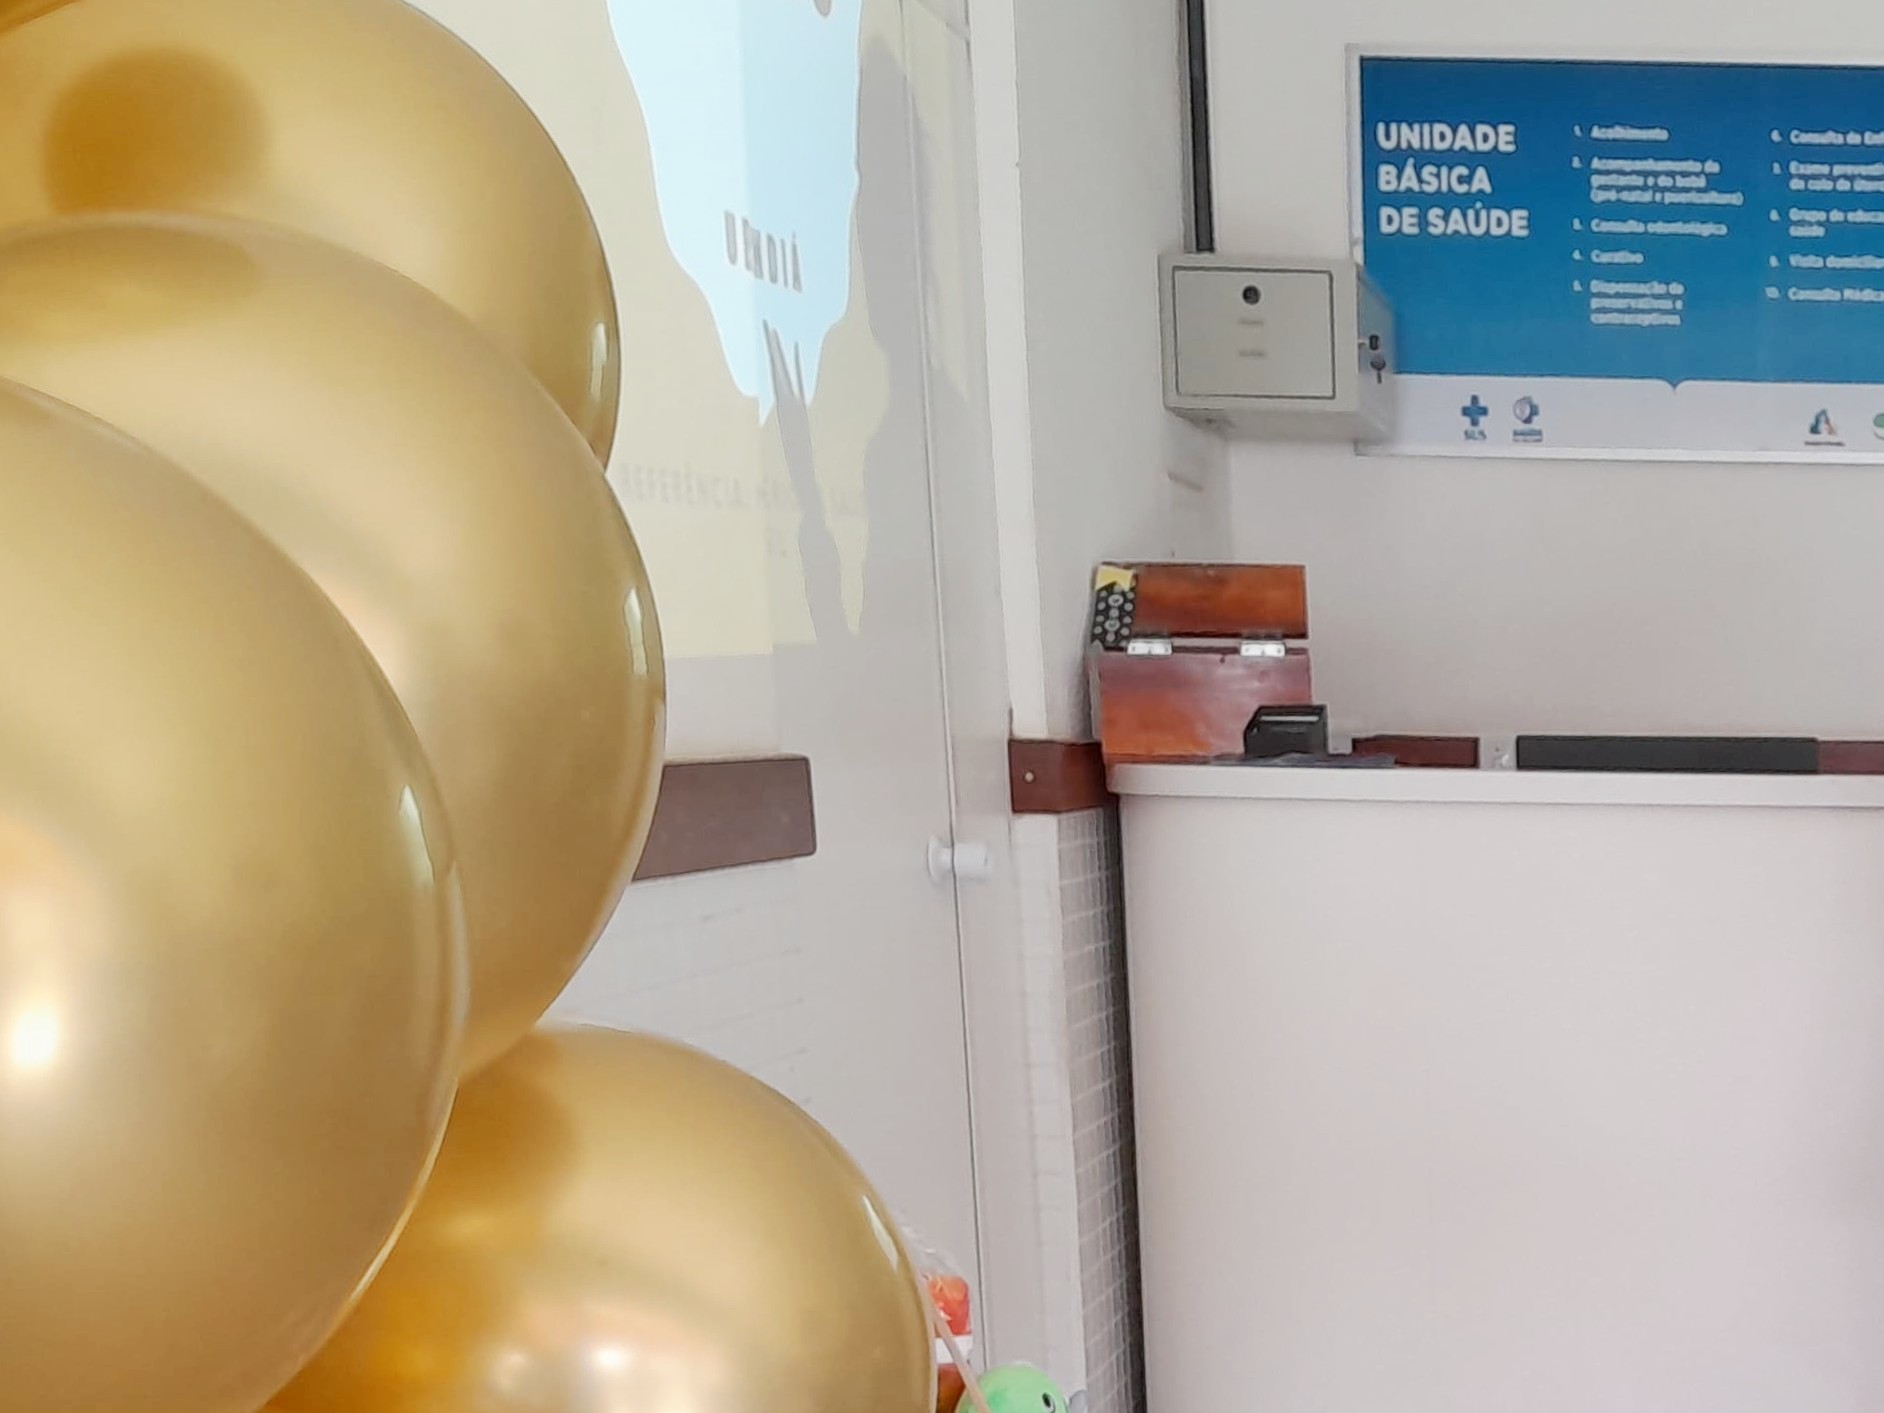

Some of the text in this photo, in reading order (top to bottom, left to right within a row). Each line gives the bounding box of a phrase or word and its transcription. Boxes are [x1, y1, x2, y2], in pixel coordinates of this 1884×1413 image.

[1376, 121, 1517, 153] UNIDADE
[1378, 156, 1493, 194] BÁSICA
[1379, 200, 1530, 238] DE SAÚDE
